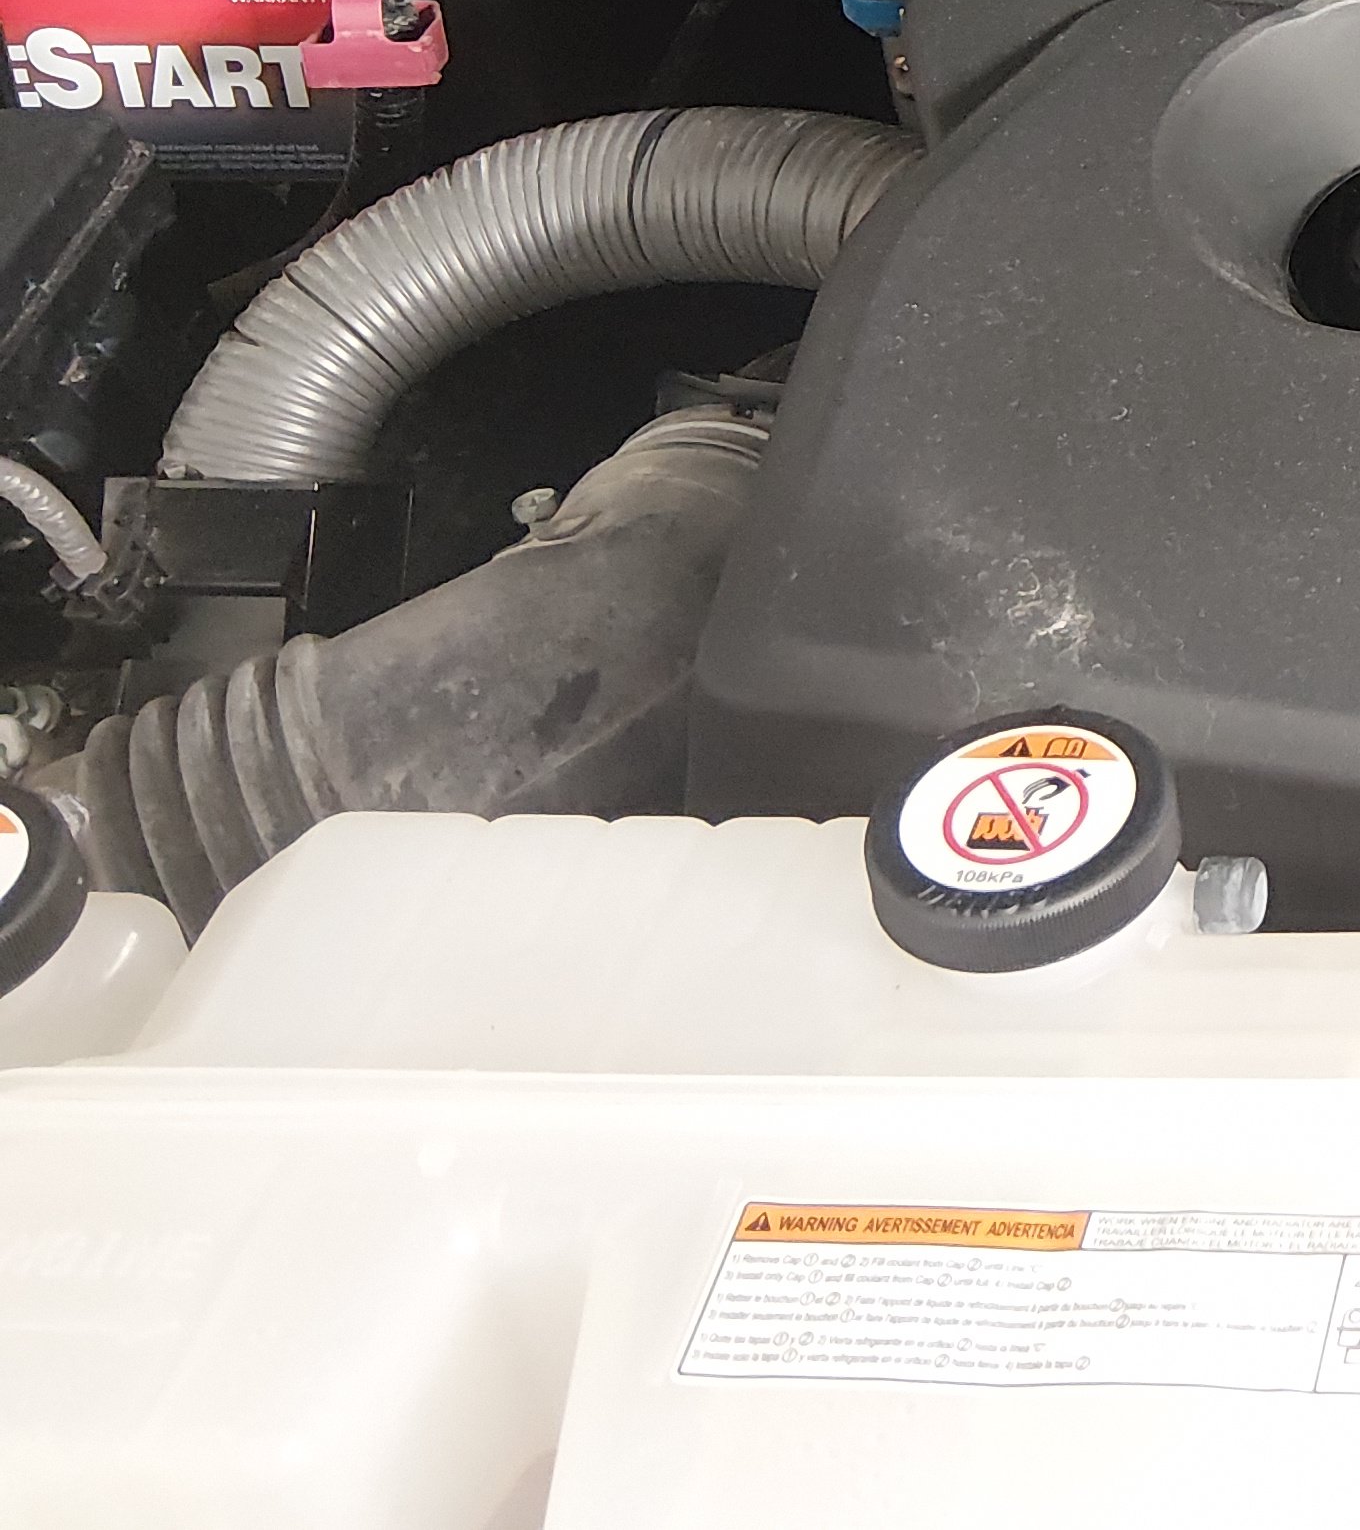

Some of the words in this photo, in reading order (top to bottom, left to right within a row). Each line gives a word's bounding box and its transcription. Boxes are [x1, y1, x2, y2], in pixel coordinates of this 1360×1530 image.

[956, 869, 1023, 883] 108kPa
[779, 1215, 857, 1232] WARNING
[863, 1217, 981, 1235] AVERTISSEMENT
[987, 1220, 1075, 1239] ADVERTENCIA
